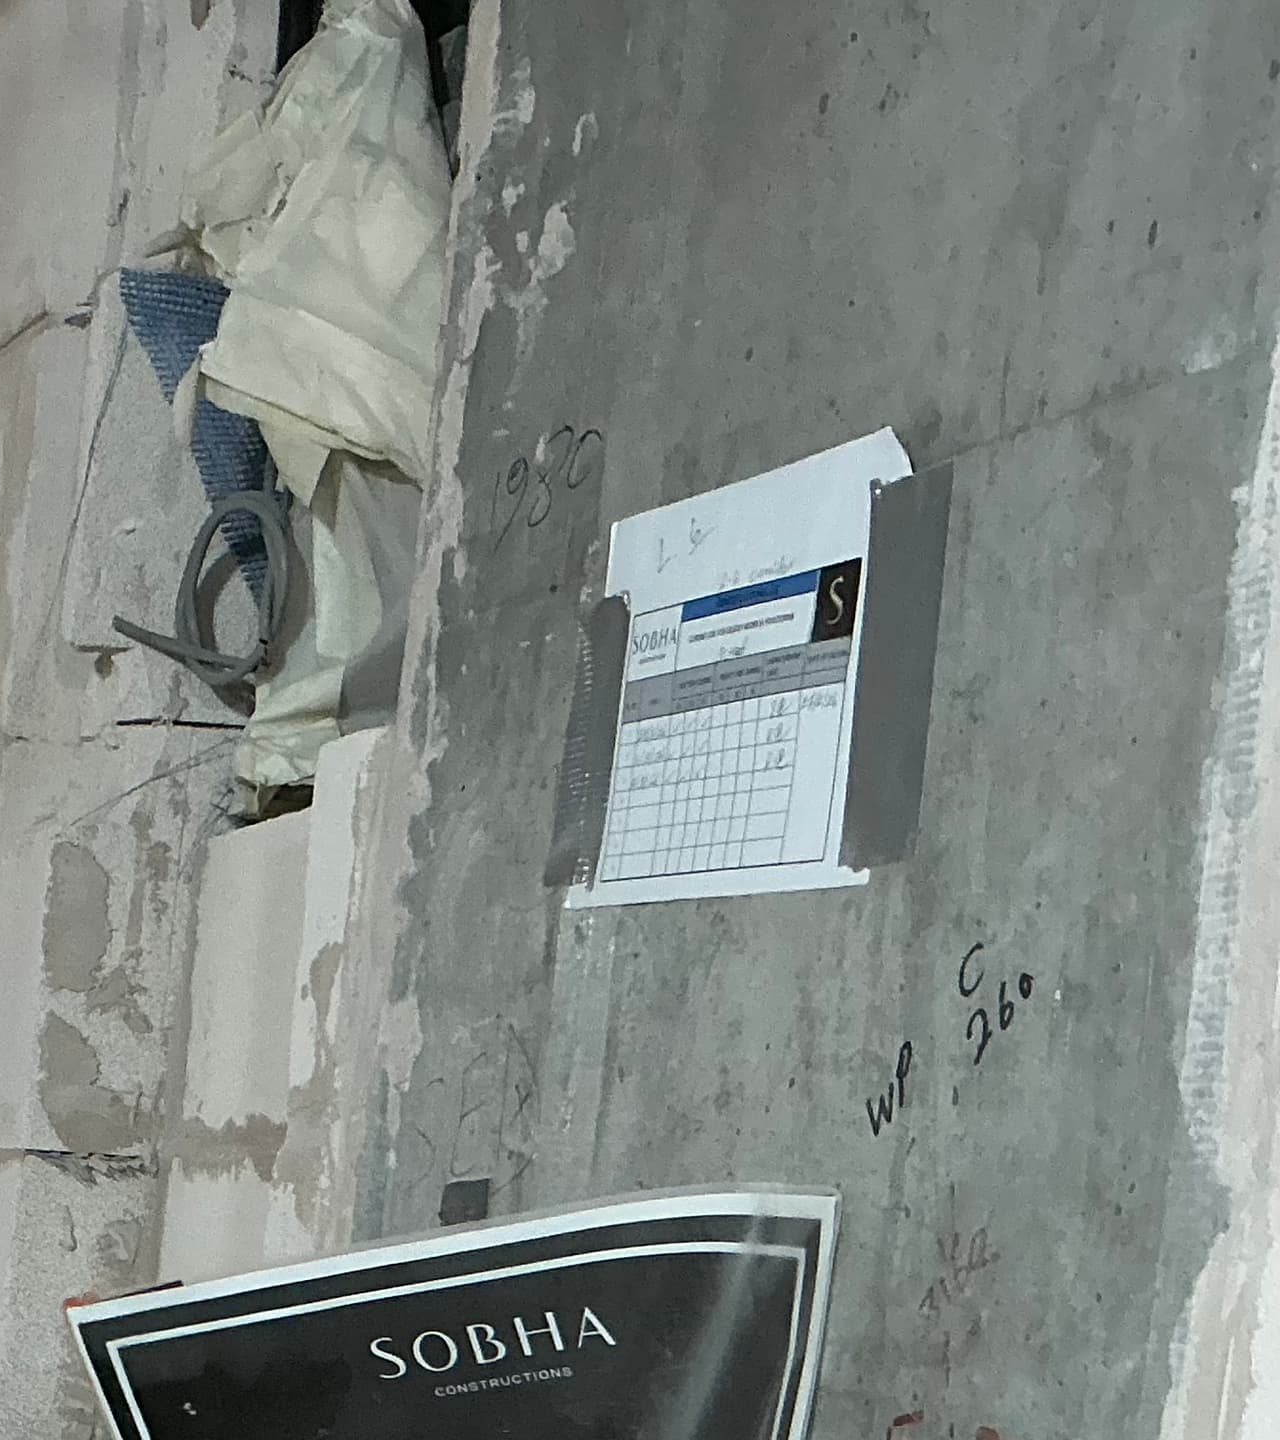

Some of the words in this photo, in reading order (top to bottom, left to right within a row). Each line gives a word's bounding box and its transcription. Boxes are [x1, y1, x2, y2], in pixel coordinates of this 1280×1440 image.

[632, 627, 677, 655] SOBHA
[369, 1306, 617, 1380] SOBHA
[433, 1365, 573, 1398] CONSTRUCTIONS
